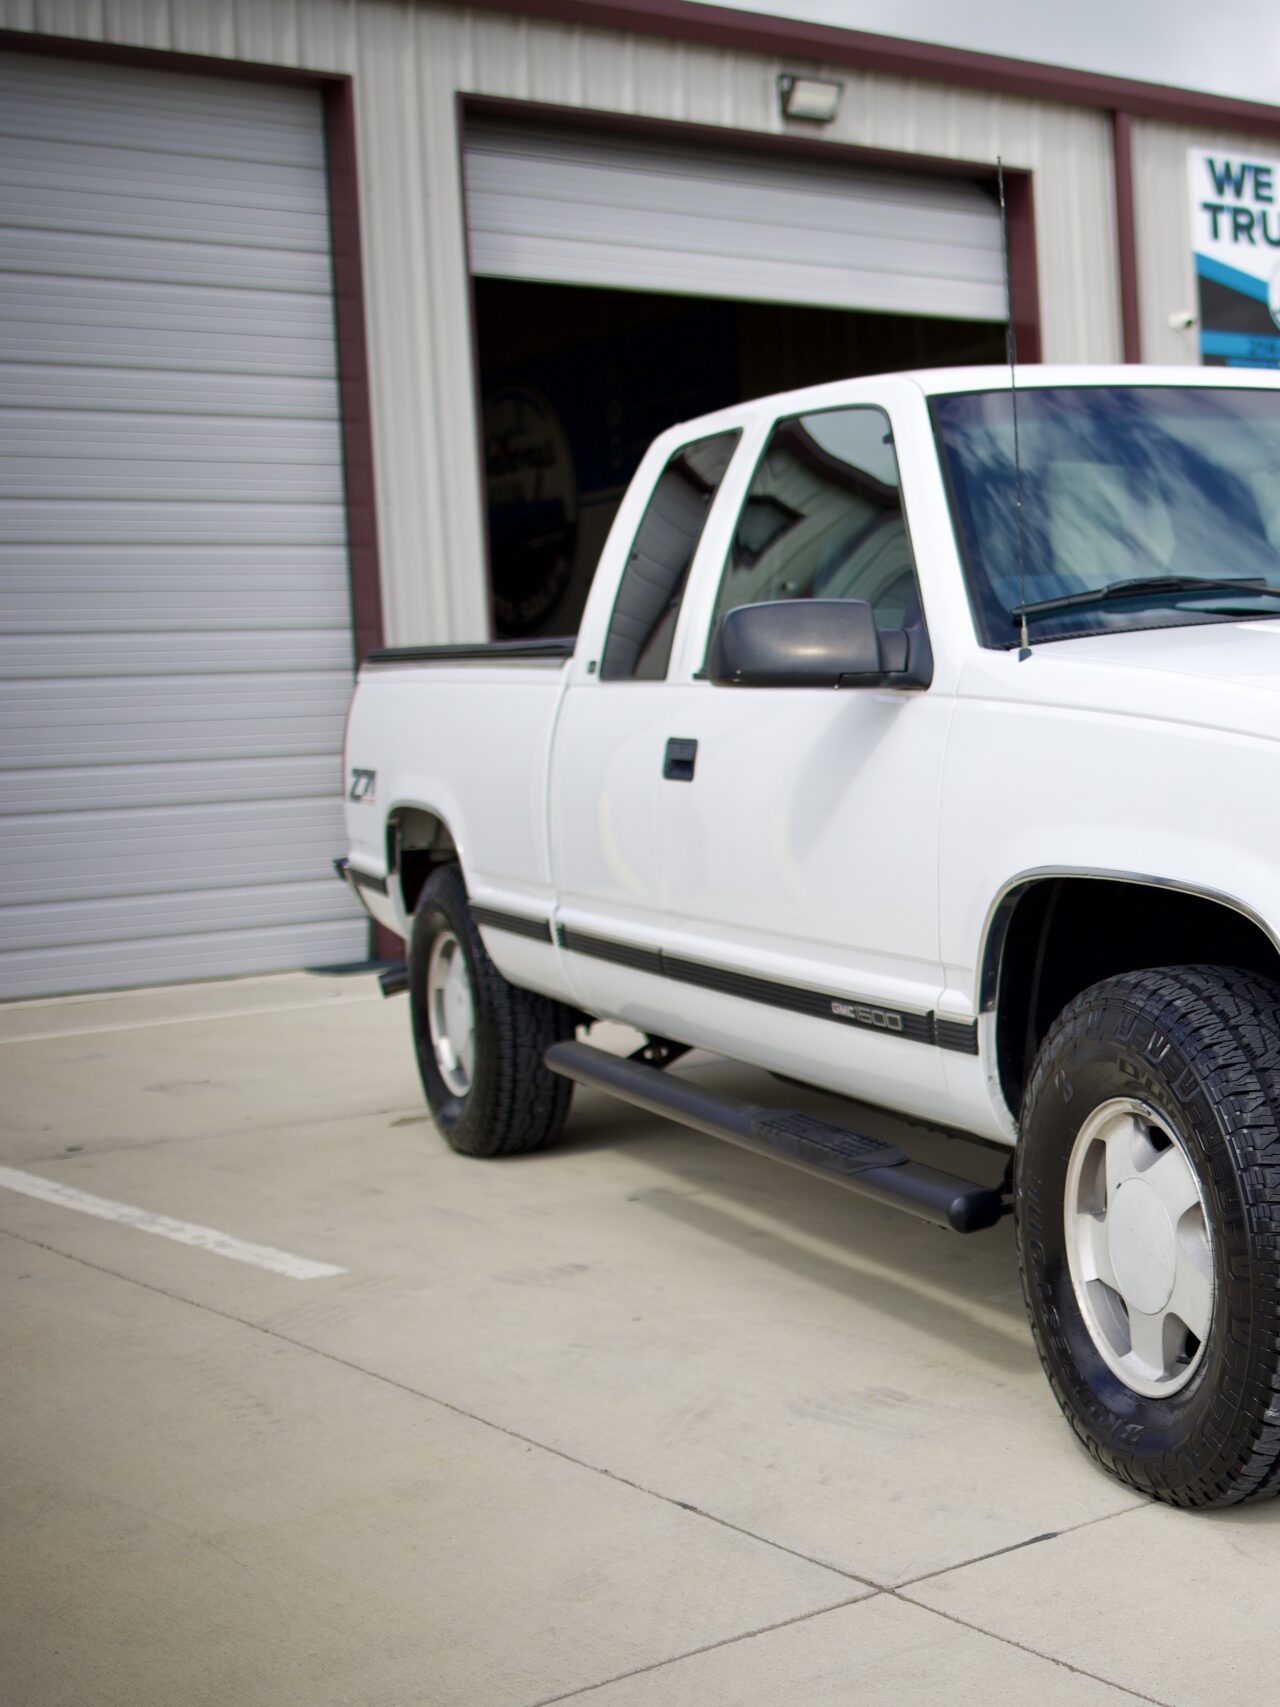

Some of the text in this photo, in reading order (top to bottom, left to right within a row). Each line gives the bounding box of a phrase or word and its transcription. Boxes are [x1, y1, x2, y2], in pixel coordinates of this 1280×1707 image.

[1205, 157, 1274, 203] WE
[832, 1002, 902, 1031] GMC 1500
